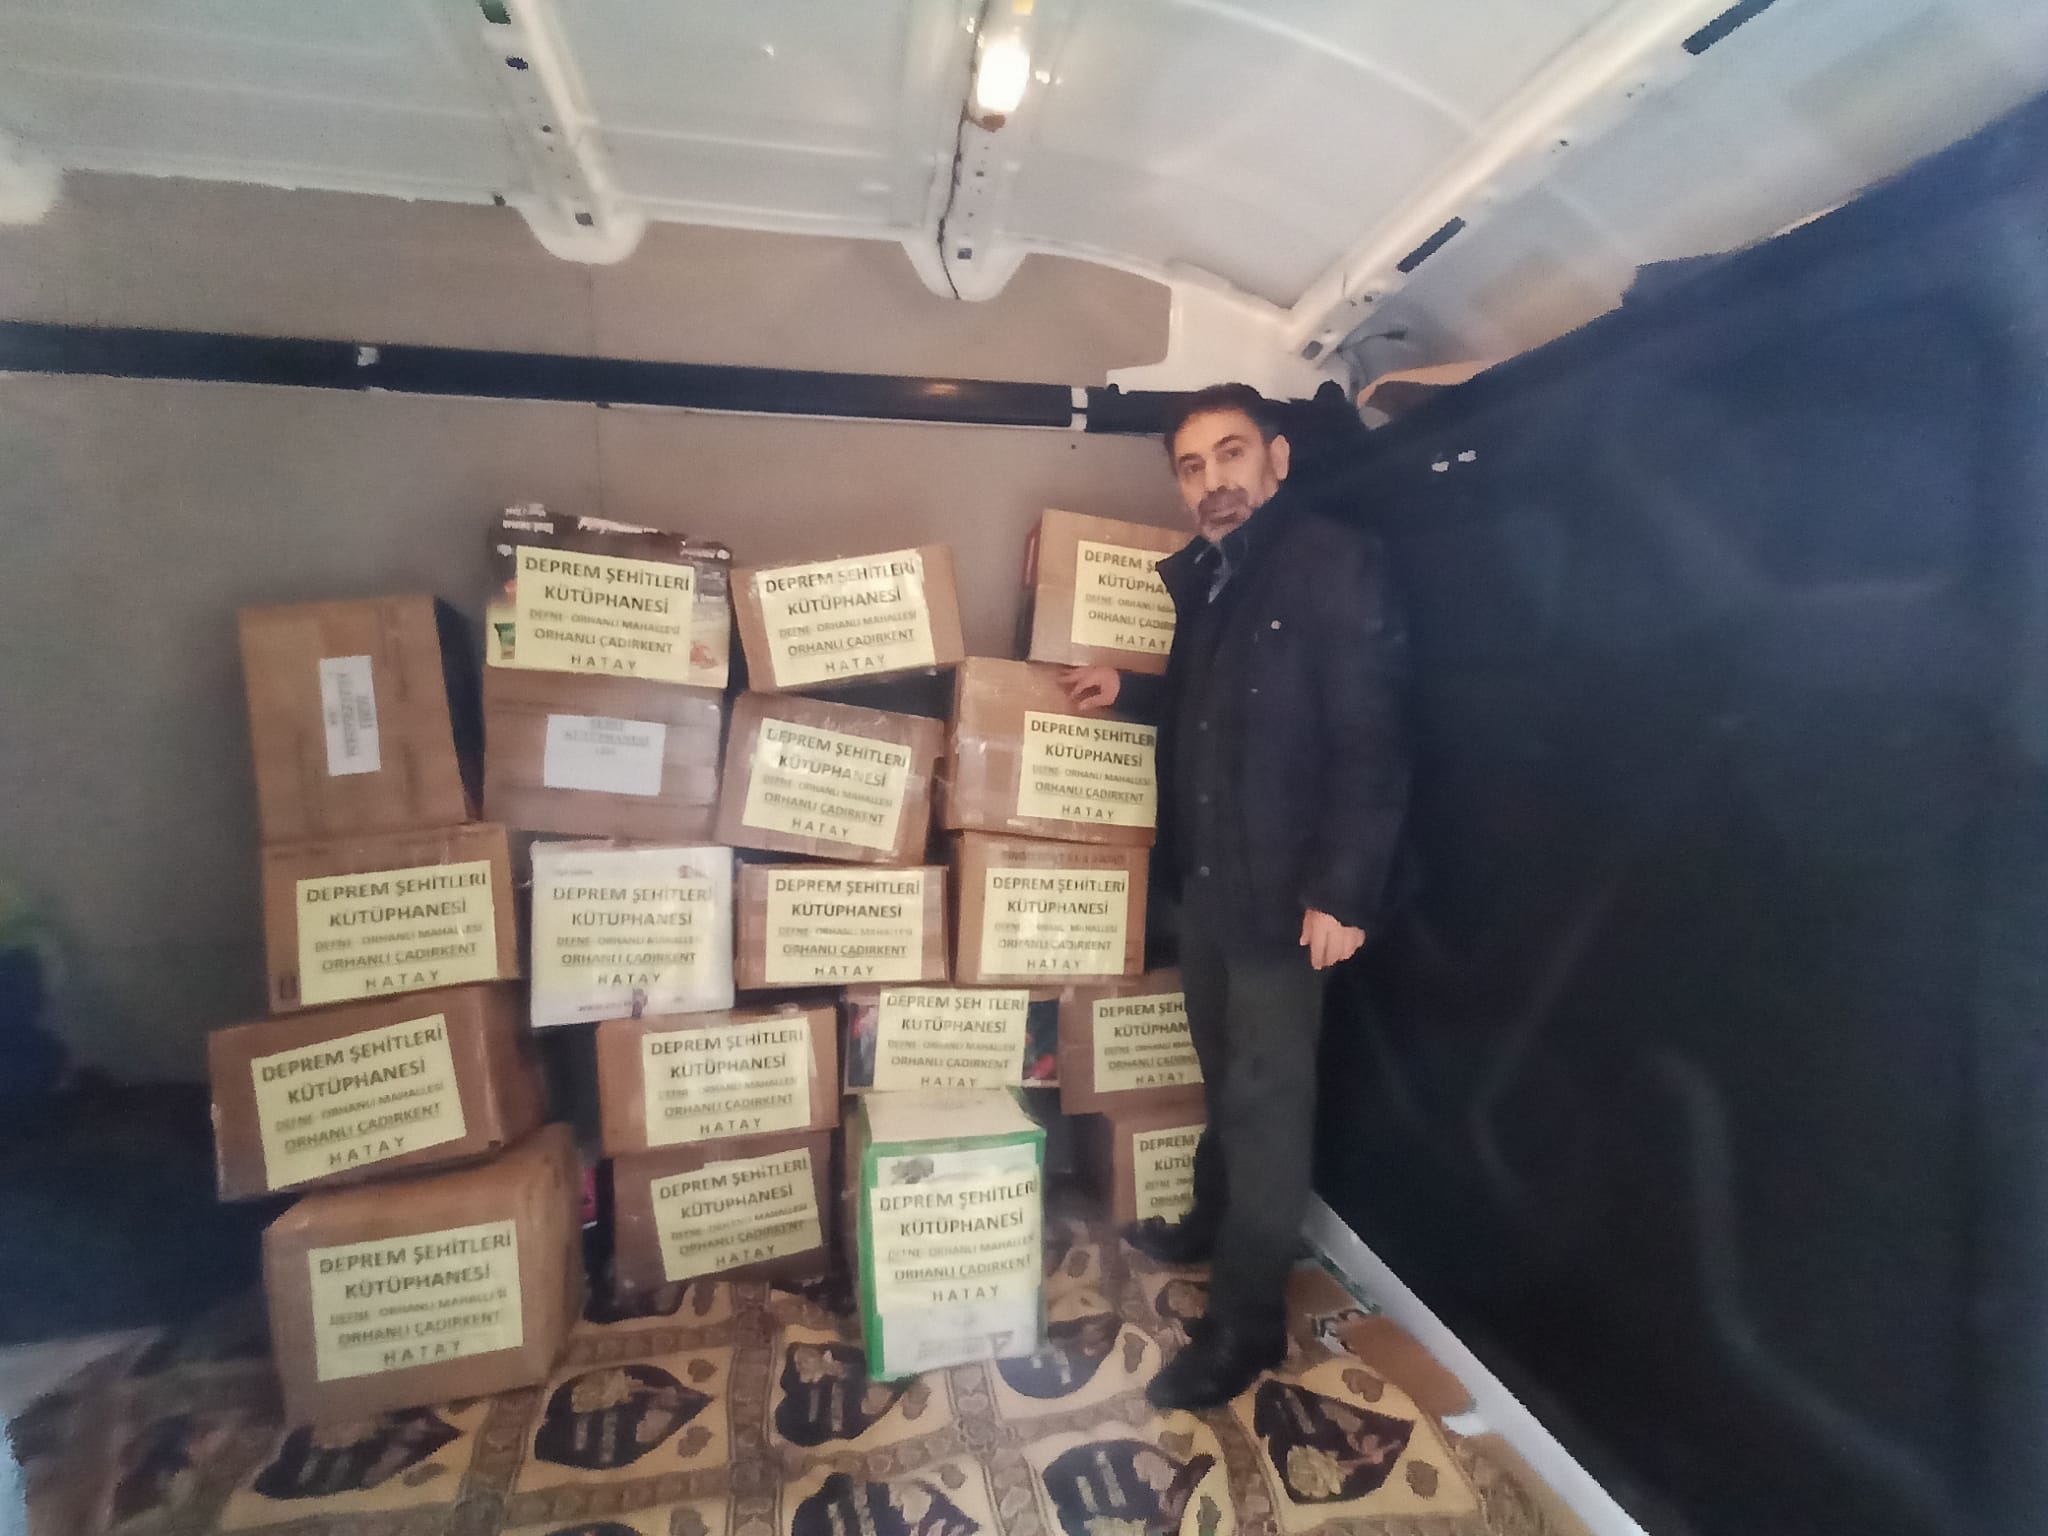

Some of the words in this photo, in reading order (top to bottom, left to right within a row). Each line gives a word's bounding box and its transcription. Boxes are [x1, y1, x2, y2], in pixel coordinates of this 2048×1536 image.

[1085, 550, 1142, 569] DEPREM
[525, 557, 600, 579] DEPREM
[606, 567, 689, 591] ŞEHİTLERİ
[766, 572, 833, 593] DEPREM
[545, 584, 669, 614] KÜTÜPHANESİ
[788, 586, 902, 616] KÜTÜPHANESİ
[1088, 610, 1135, 625] ORHANLI
[534, 629, 595, 645] ORHANLI
[600, 635, 673, 653] ÇADIRKENT
[788, 640, 843, 657] ORHANLI
[847, 629, 914, 649] ÇADIRKENT
[1031, 720, 1089, 737] DEPREM
[1094, 728, 1155, 746] ŞEHİTLER
[767, 728, 831, 752] DEPREM
[836, 742, 907, 768] ŞEHİTLERİ
[1046, 744, 1142, 766] KÜTÜPHANESİ
[779, 755, 886, 787] KÜTÜPHANESİ
[1035, 782, 1082, 795] ORHANLI
[1086, 788, 1144, 802] ÇADIRKENT
[765, 792, 817, 811] ORHANLI
[820, 804, 885, 825] ÇADIRKENT
[306, 883, 389, 903] DEPREM
[395, 872, 486, 896] ŞEHİTLERİ
[553, 887, 627, 900] DEPREM
[776, 879, 841, 892] DEPREM
[846, 880, 919, 896] ŞEHİTLERİ
[993, 877, 1054, 890] DEPREM
[1058, 877, 1125, 893] ŞEHİTLERİ
[329, 898, 466, 927] KÜTÜPHANESİ
[792, 901, 902, 918] KÜTÜPHANESİ
[1007, 898, 1108, 914] KÜTÜPHANESİ
[572, 910, 692, 926] KÜTÜPHANESİ
[322, 952, 390, 971] ORHANLI
[783, 944, 837, 955] ORHANLI
[840, 945, 906, 958] ÇADIRKENT
[887, 995, 949, 1008] DEPREM
[955, 997, 1025, 1011] ŞEHTLERİ
[1100, 1004, 1155, 1018] DEPREM
[902, 1016, 1006, 1033] KÜTÜPHANESİ
[1114, 1022, 1188, 1037] KÜTÜPHAN
[262, 1050, 344, 1082] DEPREM
[350, 1023, 443, 1064] ŞEHİTLERİ
[651, 1037, 721, 1056] DEPREM
[670, 1053, 786, 1079] KÜTÜPHANESİ
[891, 1056, 943, 1066] ORHANLI
[947, 1058, 1008, 1069] ÇADIRKENT
[288, 1055, 426, 1104] KÜTÜPHANESİ
[665, 1102, 722, 1118] ORHANLI
[725, 1095, 793, 1112] ÇADIRKENT
[285, 1126, 353, 1153] ORHANLI
[357, 1103, 440, 1135] ÇADIRKENT
[1140, 1134, 1195, 1152] DEPREM
[1155, 1154, 1192, 1171] KÜTÜ
[660, 1176, 727, 1200] DEPREM
[732, 1157, 808, 1186] ŞEHİTLERİ
[681, 1183, 793, 1219] KÜTÜPHANESİ
[880, 1194, 952, 1211] DEPREM
[901, 1208, 1023, 1236] KÜTÜPHANESİ
[319, 1248, 406, 1274] DEPREM
[414, 1230, 511, 1264] ŞEHİTLERİ
[895, 1266, 955, 1281] ORHANLI
[959, 1254, 1031, 1278] ÇADIRKENT
[345, 1263, 490, 1299] KÜTÜPHANESİ
[338, 1326, 410, 1348] ORHANLI
[415, 1311, 499, 1336] ÇADIRKENT
